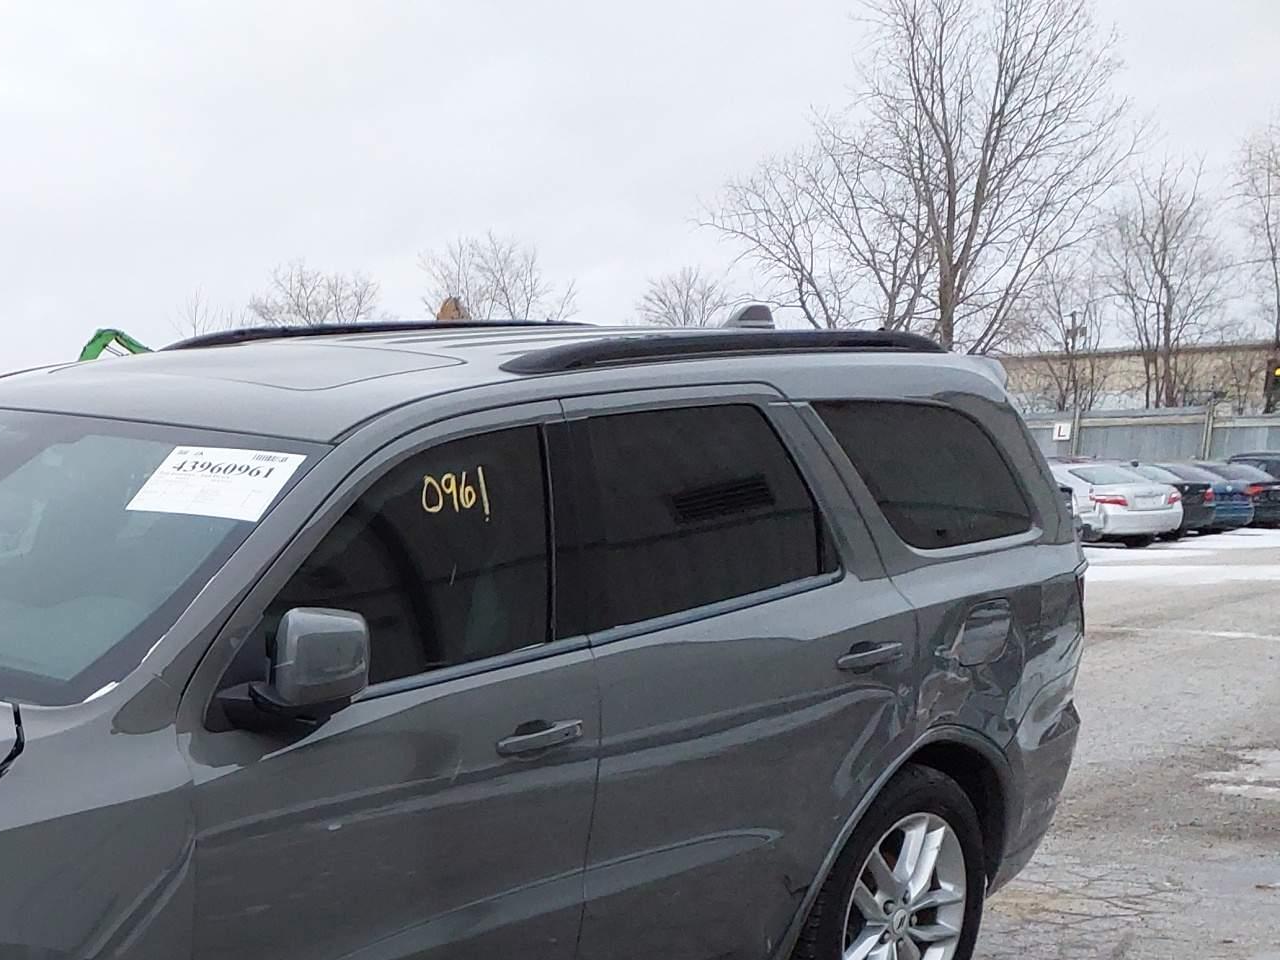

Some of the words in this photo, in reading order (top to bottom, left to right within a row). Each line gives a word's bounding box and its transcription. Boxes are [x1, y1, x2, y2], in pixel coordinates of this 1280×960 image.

[1057, 425, 1066, 438] L
[171, 459, 276, 479] 43960961
[421, 465, 490, 522] 0961
